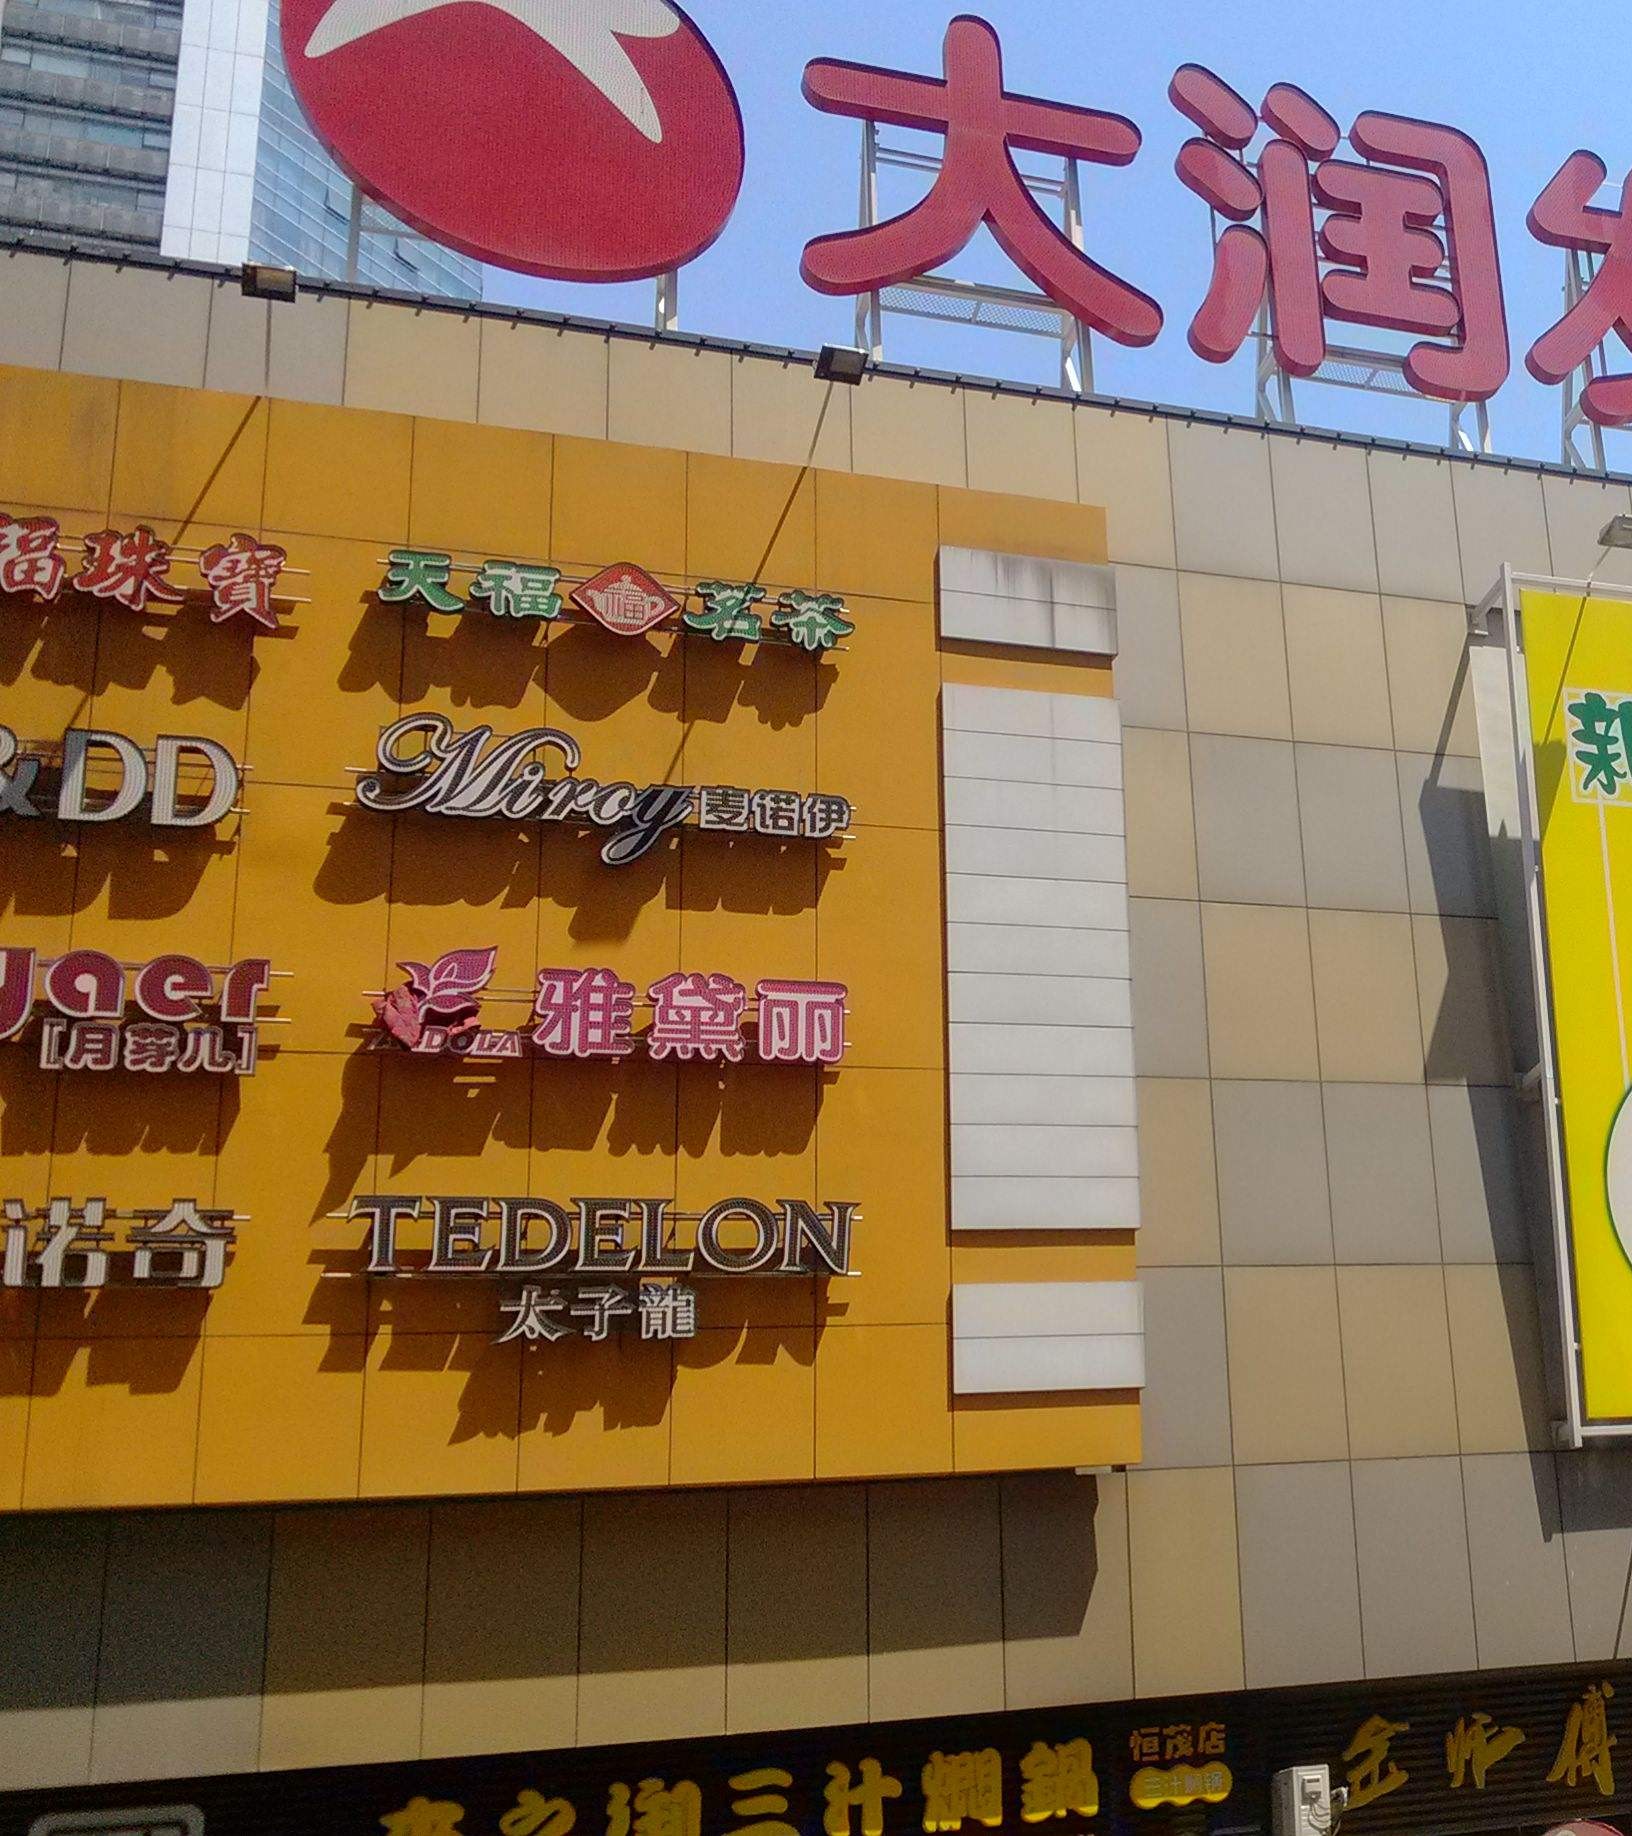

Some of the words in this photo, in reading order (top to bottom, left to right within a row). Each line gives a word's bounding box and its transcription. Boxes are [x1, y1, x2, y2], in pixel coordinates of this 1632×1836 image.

[533, 967, 848, 1063] 雅黛丽
[349, 1195, 862, 1275] TEDELON
